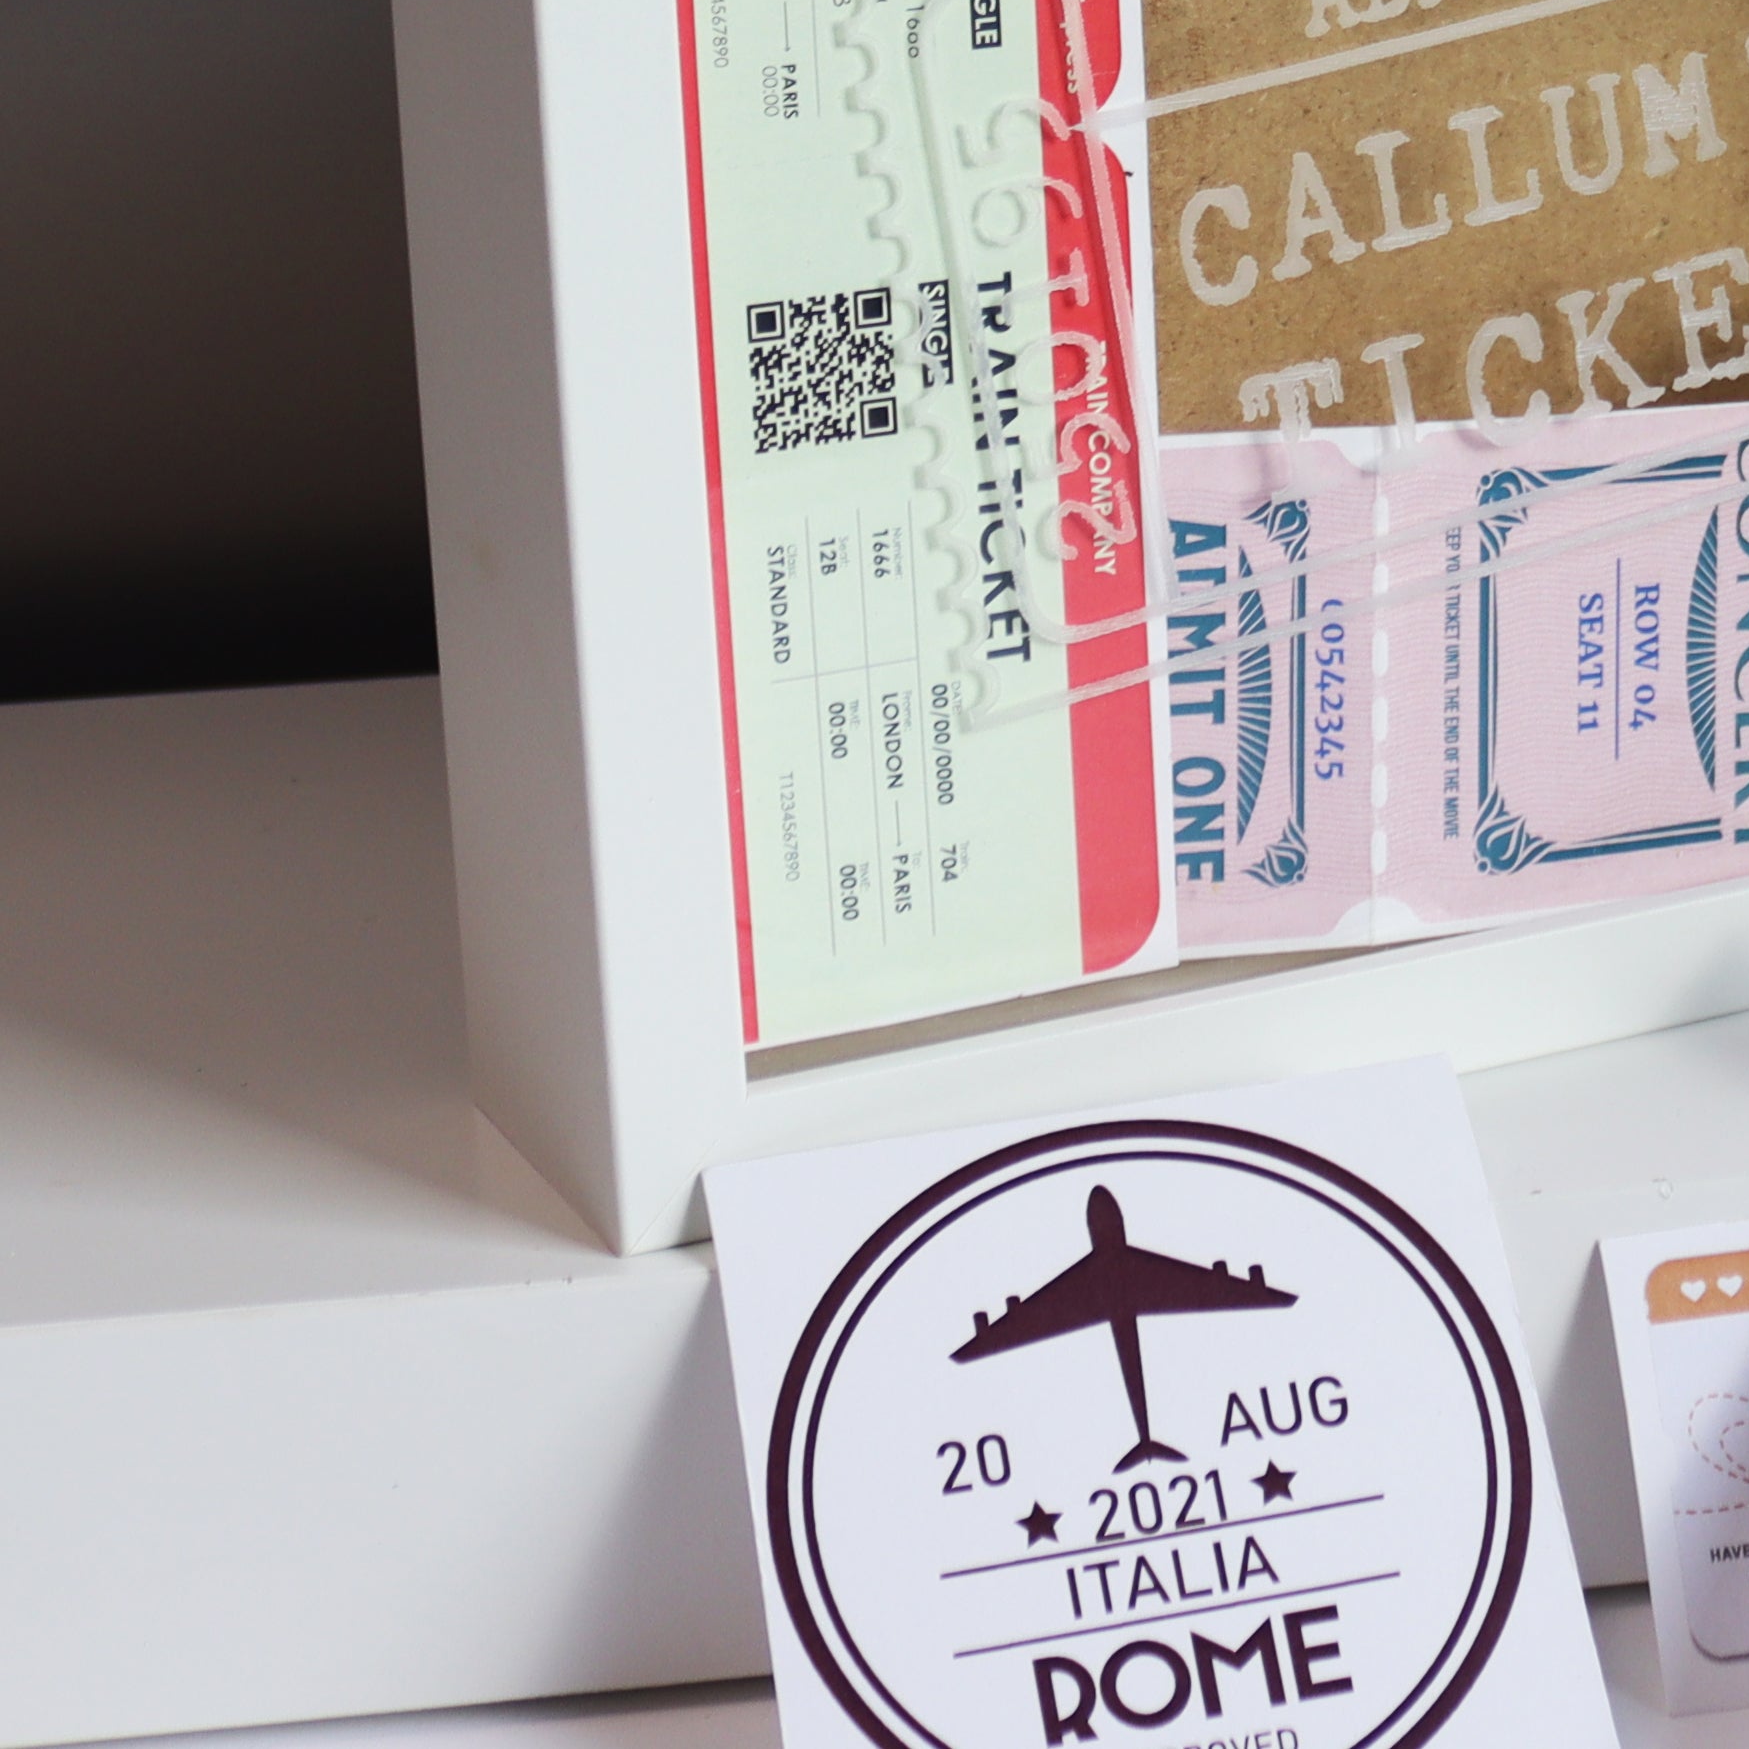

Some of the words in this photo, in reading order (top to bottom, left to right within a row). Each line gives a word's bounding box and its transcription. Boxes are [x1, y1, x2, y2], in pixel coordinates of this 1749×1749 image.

[762, 66, 779, 117] 00:00
[781, 64, 799, 119] PARIS
[1086, 340, 1109, 415] TAIN
[818, 537, 838, 576] 12B
[872, 528, 891, 579] 1666
[1446, 526, 1461, 552] EEP
[767, 545, 791, 664] STANDARD
[1445, 595, 1461, 640] TICKET
[1633, 583, 1660, 671] ROW
[1444, 645, 1460, 684] UNTIL
[1577, 593, 1604, 689] SEAT
[1444, 687, 1460, 713] THE
[1577, 701, 1599, 734] 11
[1628, 684, 1656, 731] 04
[931, 683, 954, 805] 00/00/0000
[1444, 717, 1460, 742] END
[1444, 746, 1460, 763] OF
[882, 692, 903, 789] LONDON
[893, 854, 912, 913] PARIS
[1444, 767, 1460, 793] THE
[779, 771, 800, 883] T1234567890
[828, 702, 848, 760] 00:00
[840, 864, 859, 921] 00:00
[1171, 756, 1226, 884] ONE
[1444, 797, 1459, 840] MOVIE
[940, 845, 958, 883] 704
[936, 1433, 1012, 1497] 20
[1219, 1375, 1350, 1446] AUG
[1088, 1469, 1228, 1543] 2021
[1066, 1536, 1280, 1620] ITALIA
[1032, 1604, 1354, 1748] ROME
